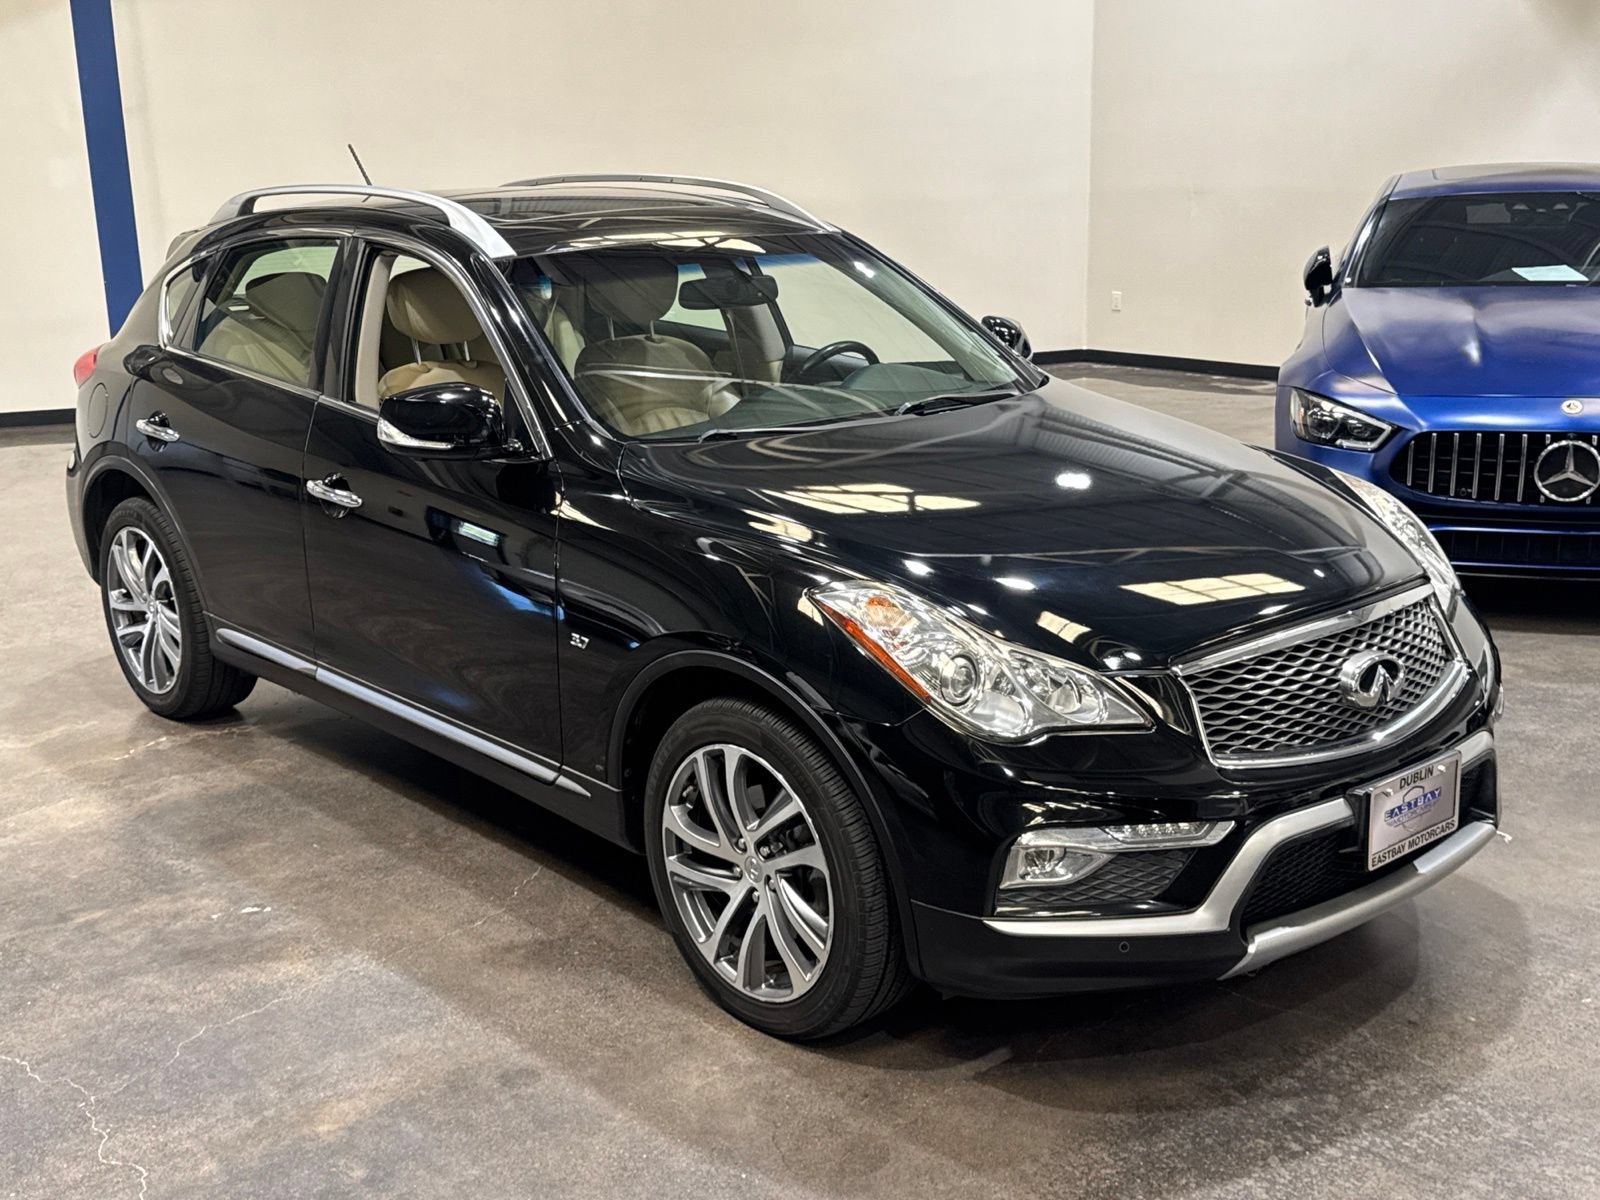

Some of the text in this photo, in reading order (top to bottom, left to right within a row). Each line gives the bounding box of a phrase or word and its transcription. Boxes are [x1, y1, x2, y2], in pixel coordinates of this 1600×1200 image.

[1400, 765, 1434, 789] DUBLIN
[1385, 788, 1441, 821] EASTBAY
[1372, 820, 1455, 868] EASTBAY MOTORCARS
